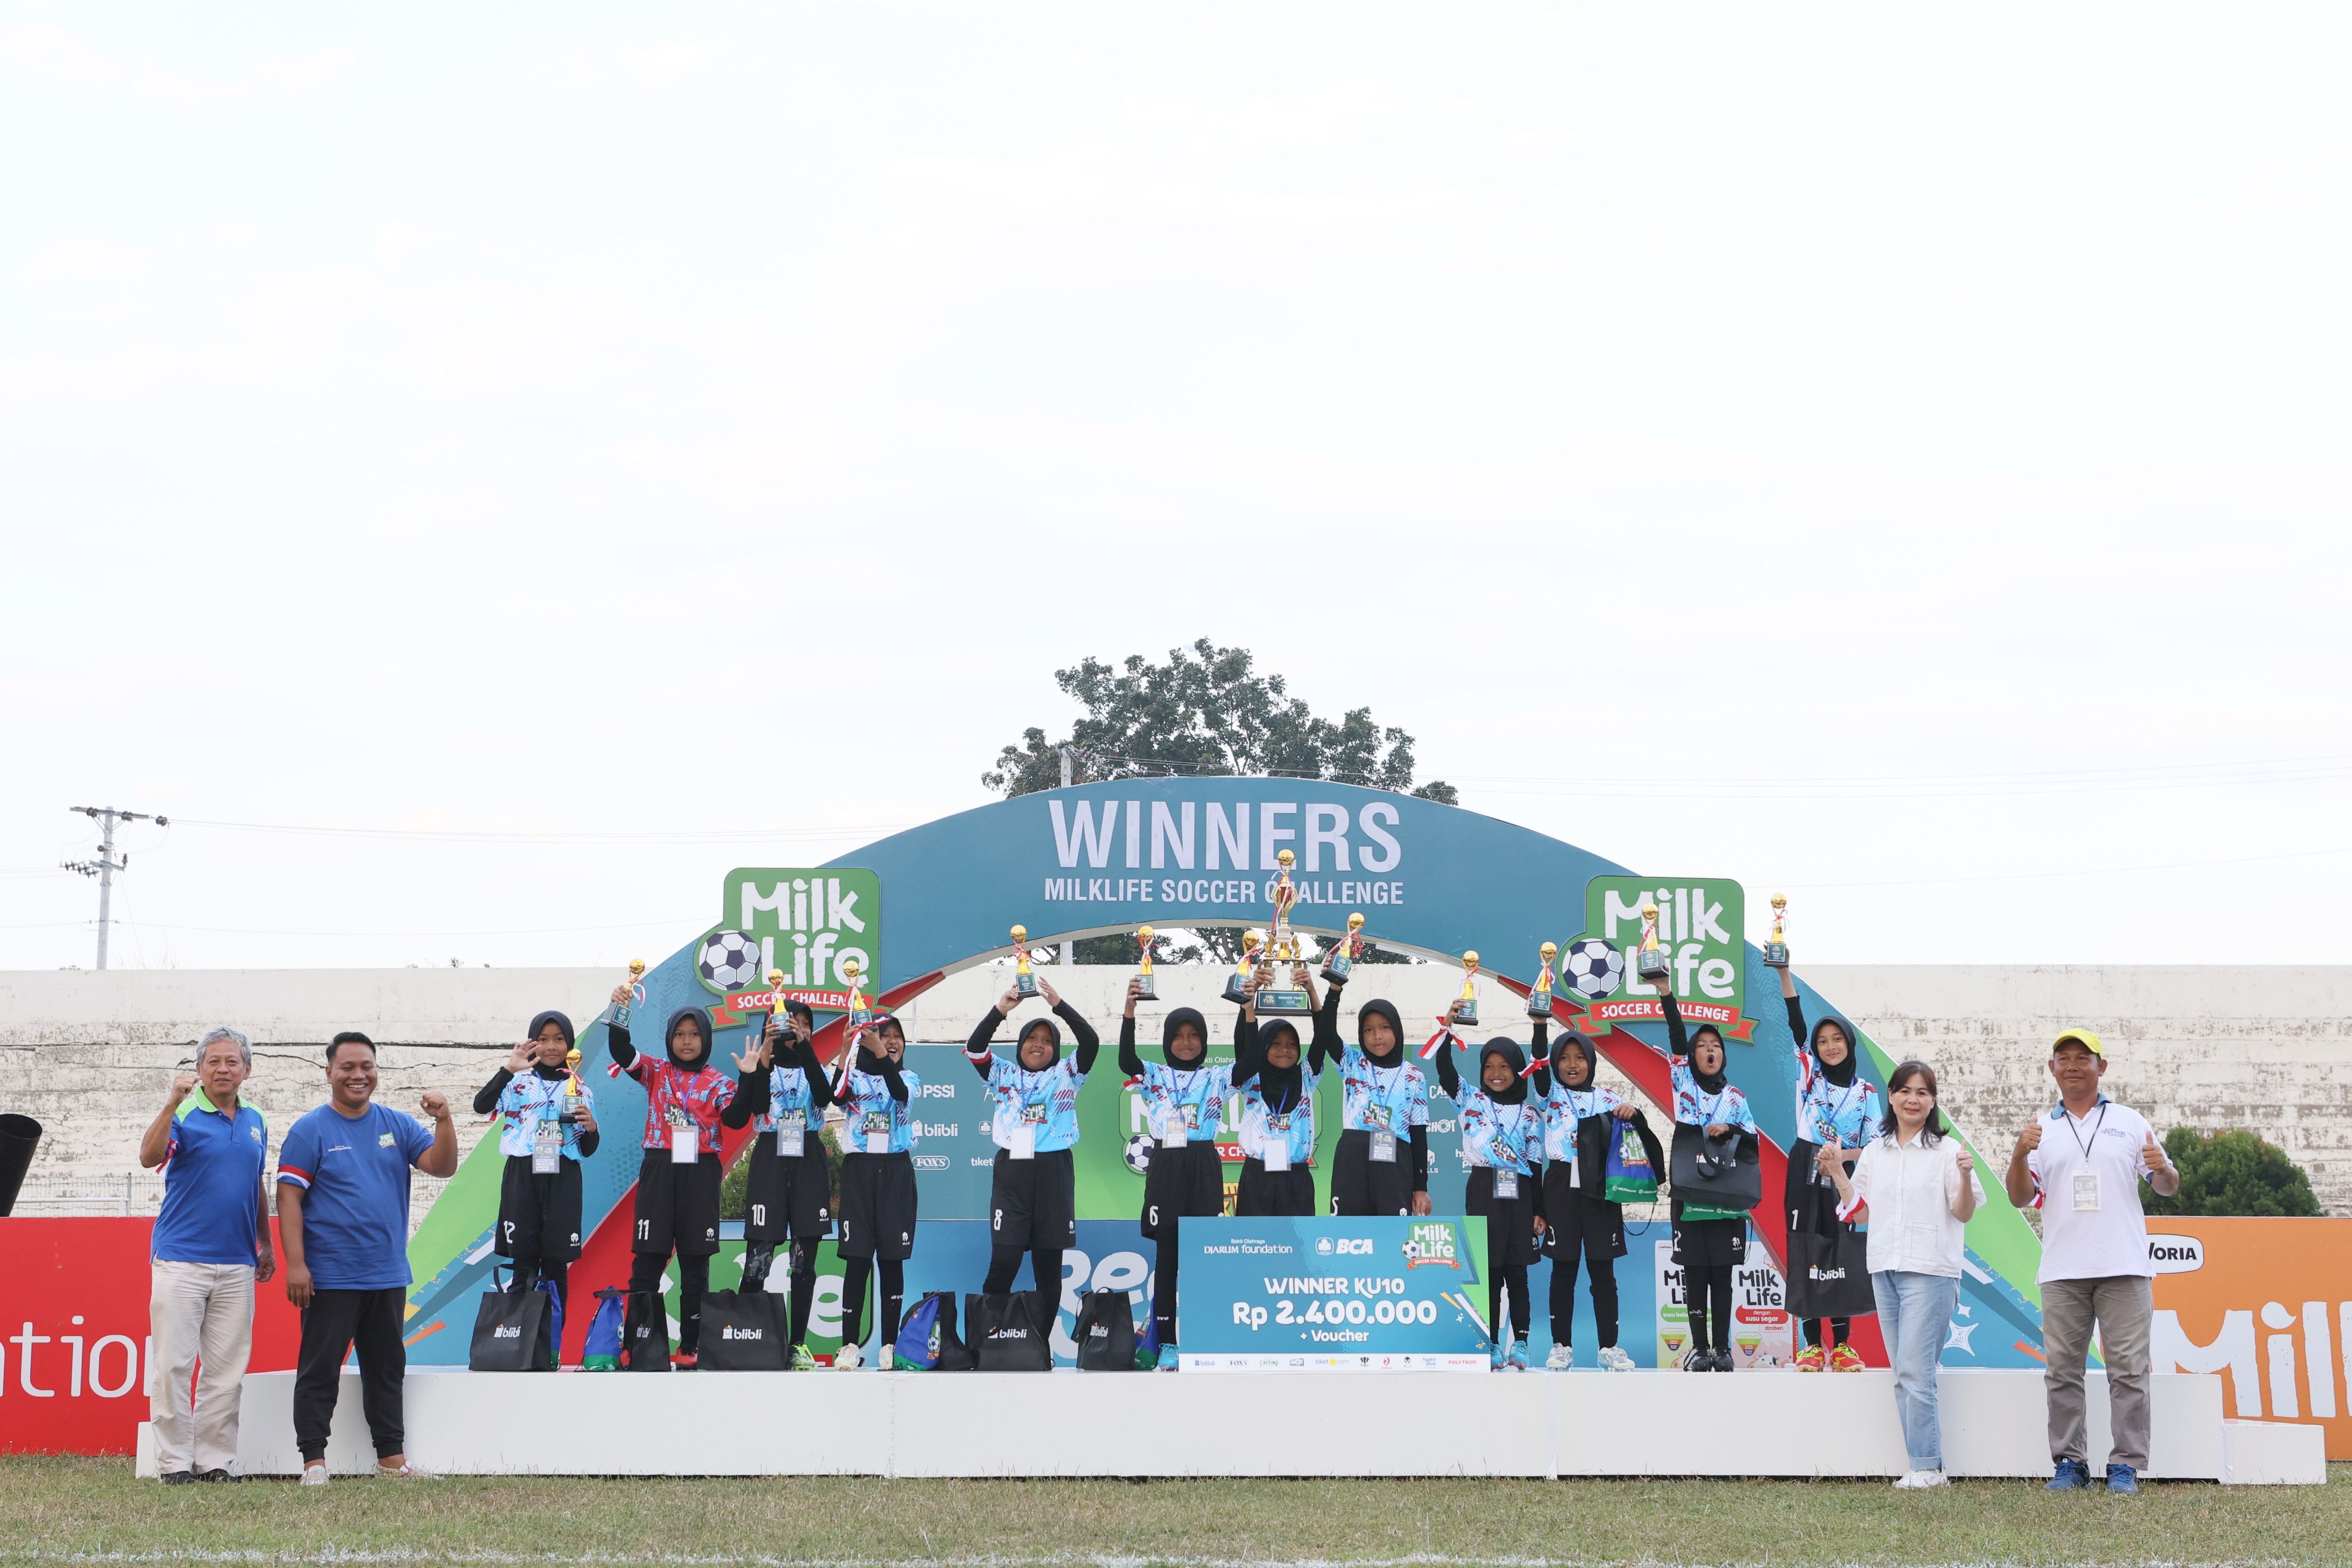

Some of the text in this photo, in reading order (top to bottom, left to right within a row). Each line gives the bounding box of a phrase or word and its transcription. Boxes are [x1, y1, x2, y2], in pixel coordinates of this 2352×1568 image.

[1048, 800, 1401, 873] WINNERS
[1044, 878, 1404, 905] MILKLIFE SOCCER CALLENGE
[741, 878, 865, 933] Milk
[1604, 887, 1731, 945] Milk
[761, 933, 870, 988] Life
[1602, 1003, 1652, 1018] SOCCER
[923, 1084, 955, 1098] PSSI
[925, 1123, 958, 1137] blibli
[752, 1204, 765, 1226] 10
[994, 1209, 1003, 1231] 8
[1150, 1205, 1158, 1226] 6
[1792, 1209, 1799, 1231] 1
[503, 1221, 515, 1244] 12
[638, 1219, 650, 1240] 11
[843, 1221, 849, 1242] 9
[1414, 1224, 1452, 1241] Milk
[1204, 1244, 1292, 1254] DJARUM foundation
[1336, 1239, 1373, 1254] BCA
[1421, 1241, 1454, 1257] Life
[1674, 1230, 1681, 1252] 2
[1739, 1269, 1779, 1287] Milk
[1819, 1267, 1845, 1281] blibli
[1263, 1277, 1405, 1300] WINNER KU10
[1746, 1288, 1782, 1306] Life
[1232, 1299, 1437, 1331] Rp 2.400.000
[734, 1328, 762, 1340] blibli
[999, 1329, 1027, 1339] blibli
[1311, 1330, 1369, 1342] Voucher
